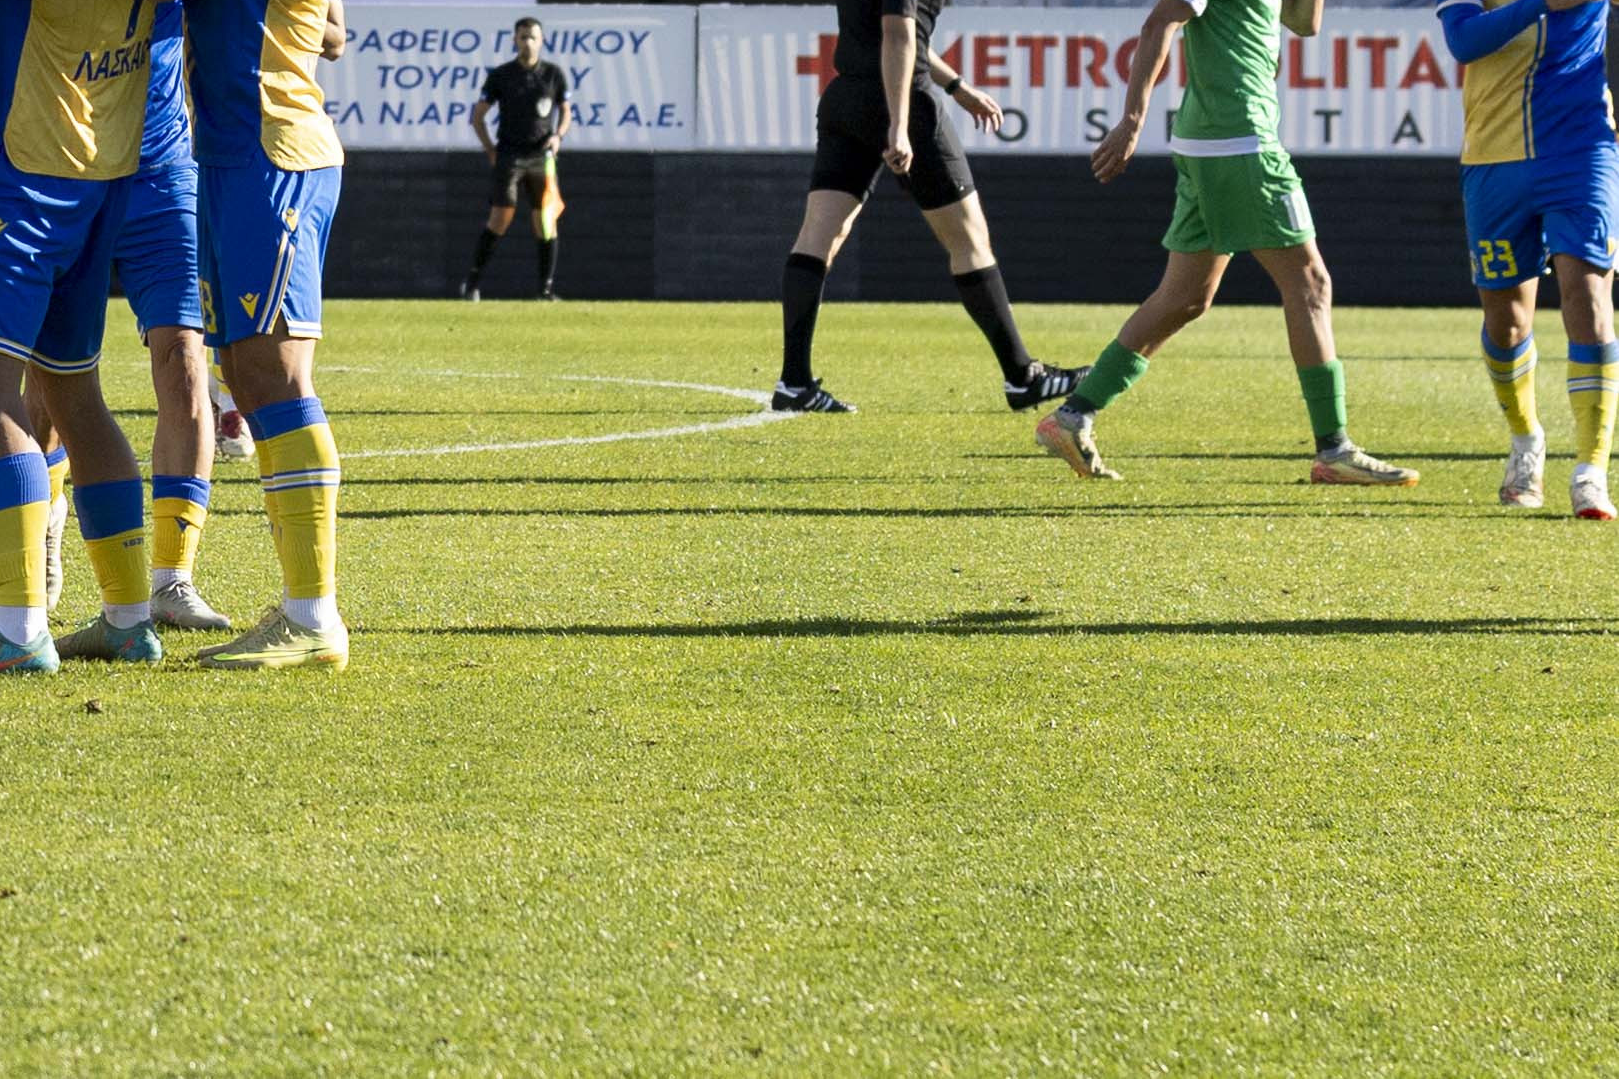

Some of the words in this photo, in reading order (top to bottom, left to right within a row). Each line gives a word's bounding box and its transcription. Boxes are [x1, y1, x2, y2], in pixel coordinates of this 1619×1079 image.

[345, 28, 481, 53] ΡΑΦΕΙΟ
[493, 30, 651, 54] ΓΝΙΚΟΥ
[377, 65, 592, 89] ΤΟΥΡΙΥ
[617, 103, 684, 127] Α.Ε.
[1478, 239, 1518, 279] 23
